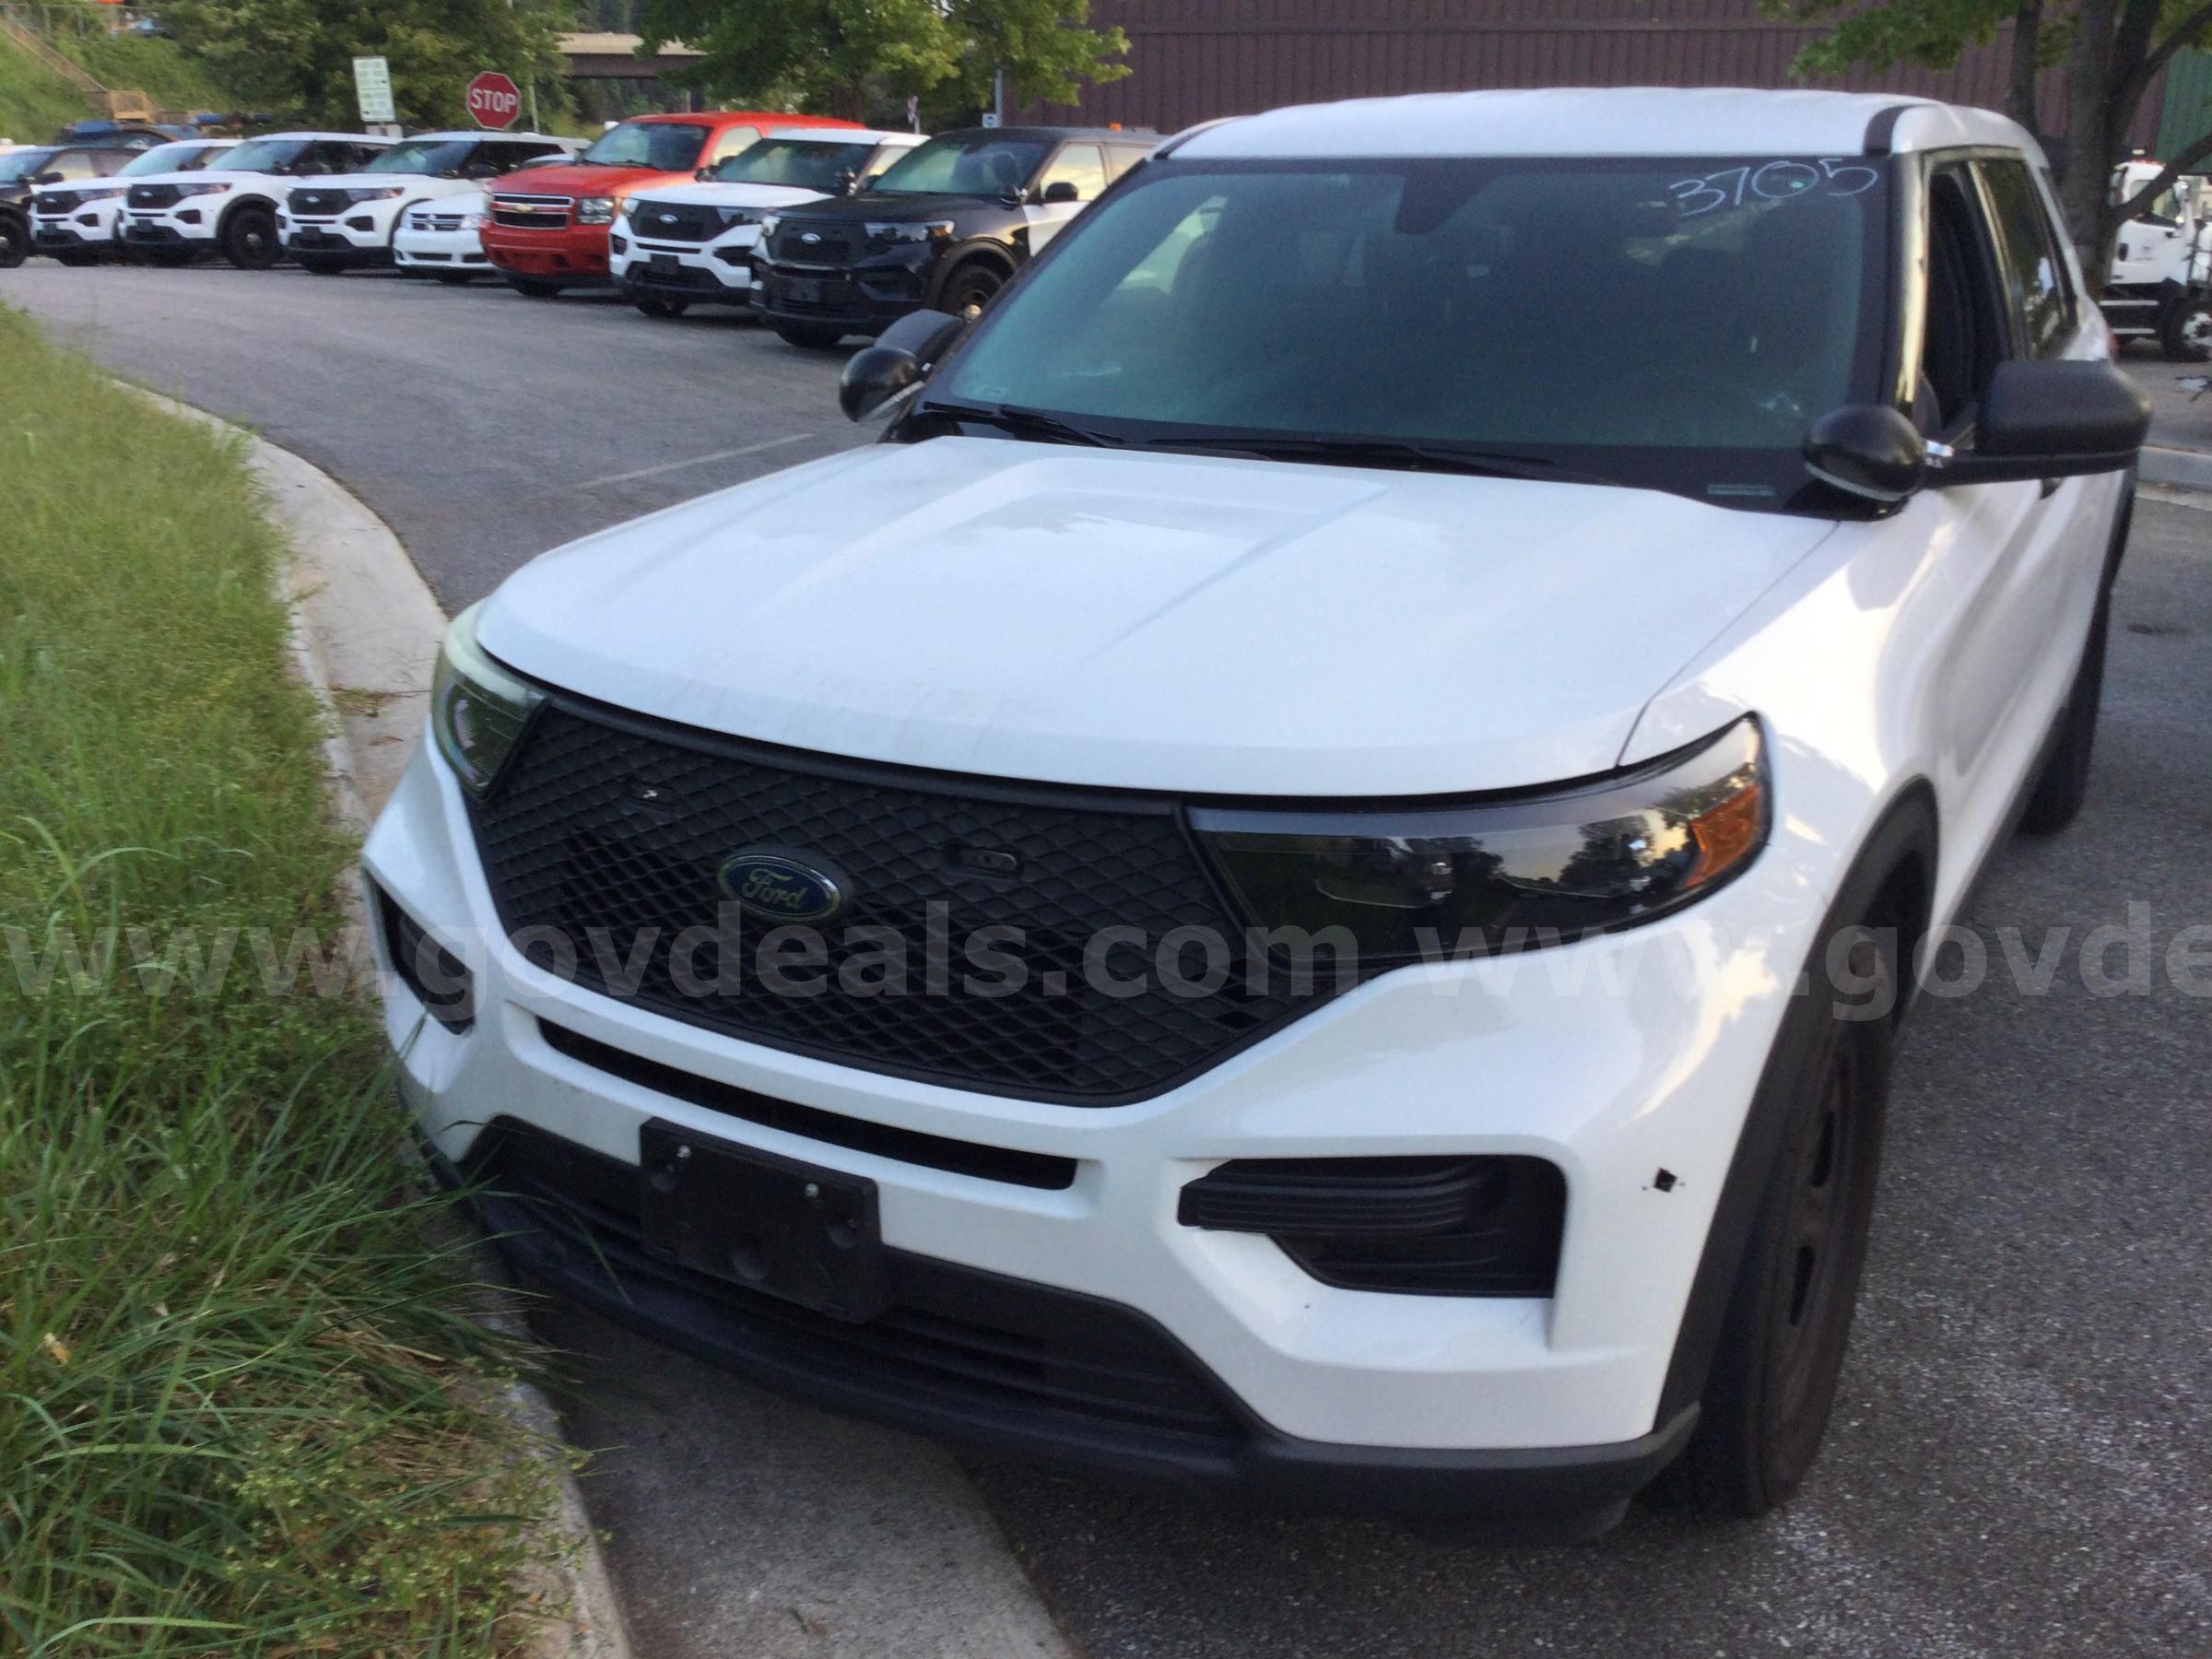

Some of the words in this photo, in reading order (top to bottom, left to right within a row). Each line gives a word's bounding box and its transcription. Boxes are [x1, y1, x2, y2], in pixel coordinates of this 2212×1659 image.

[471, 88, 517, 113] STOP
[1667, 158, 1879, 218] 3705
[741, 867, 810, 910] Ford
